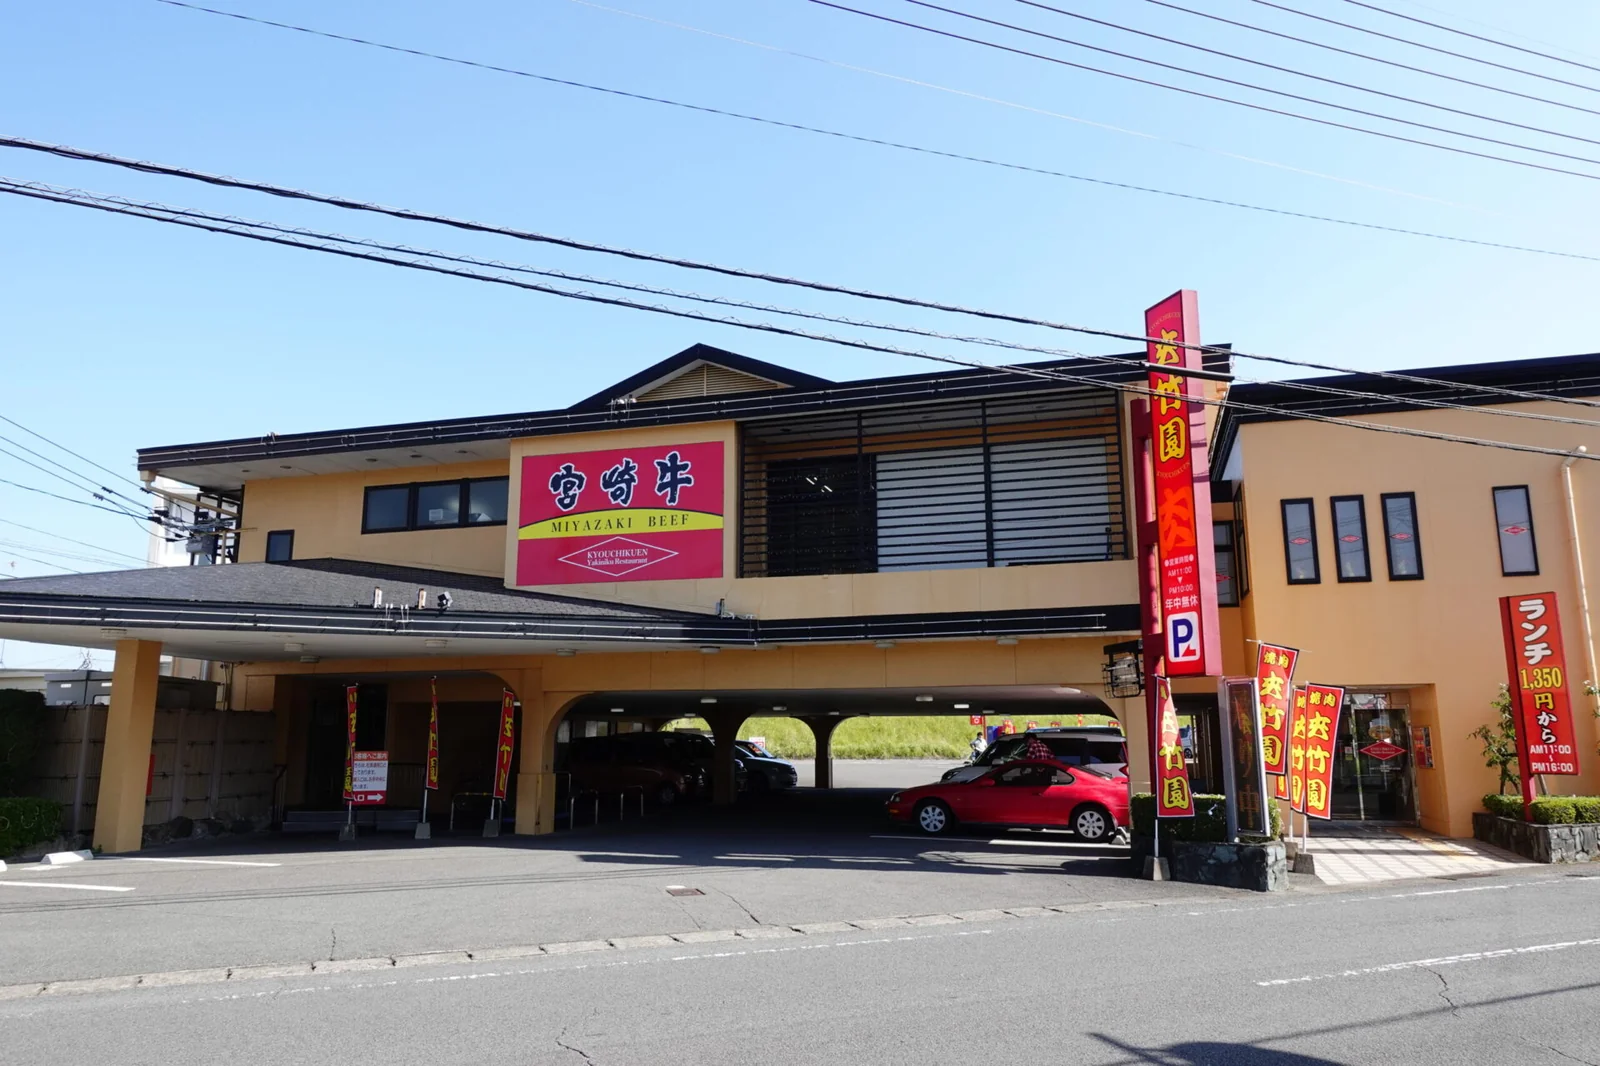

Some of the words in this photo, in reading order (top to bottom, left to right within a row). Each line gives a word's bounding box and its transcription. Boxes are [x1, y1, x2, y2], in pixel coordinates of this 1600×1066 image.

[549, 451, 694, 511] 宮崎牛
[551, 517, 632, 533] MIYAZAKI
[648, 513, 690, 527] BEEF
[587, 548, 648, 559] KYOUCHIKUEN
[587, 558, 613, 566] Yakiniku
[615, 557, 648, 566] Restaurant
[1168, 566, 1192, 577] AM11:00
[1168, 584, 1193, 595] PM10:00
[1165, 595, 1199, 611] 年中無休
[1172, 618, 1193, 658] P
[1518, 599, 1552, 665] ランチ
[1520, 667, 1562, 690] 1,350
[1534, 692, 1558, 744] 円から
[1529, 744, 1571, 755] AM11:00
[1532, 762, 1573, 773] PM16:00
